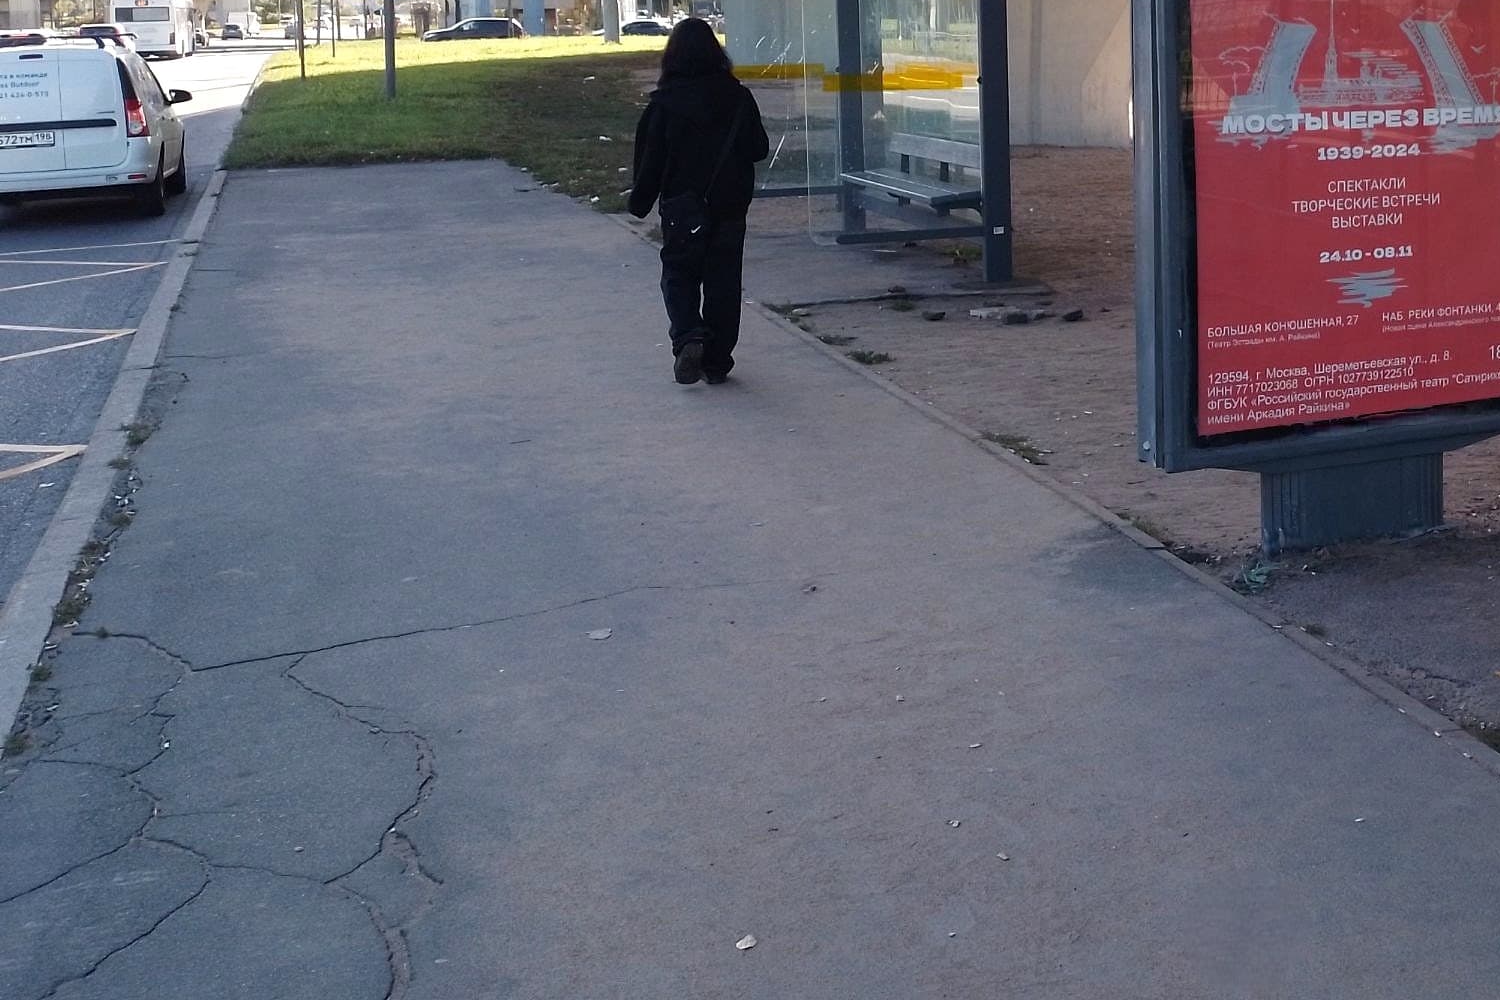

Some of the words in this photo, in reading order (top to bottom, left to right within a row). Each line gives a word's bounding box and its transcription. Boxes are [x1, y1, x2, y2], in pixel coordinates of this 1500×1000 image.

[1221, 111, 1328, 135] МОСТЫ
[1333, 108, 1420, 130] ЧЕРЕЗ
[1317, 143, 1420, 161] 1939-2024
[1327, 177, 1406, 193] СПЕКТАКЛИ
[1292, 196, 1379, 213] ТВОРЧЕСКИЕ
[1382, 193, 1441, 208] ВСТРЕЧИ
[1331, 213, 1403, 229] ВЫСТАВКИ
[1319, 249, 1363, 263] 24.10
[1373, 245, 1413, 259] 08.11
[1382, 310, 1405, 322] НАБ.
[1408, 308, 1435, 320] РЕКИ
[1437, 302, 1494, 317] ФОНТАНКИ,
[1207, 323, 1262, 338] БОЛЬШАЯ
[1264, 316, 1345, 333] КОНЮШЕННАЯ,
[1347, 314, 1359, 326] 27
[1208, 371, 1253, 385] 129594,
[1266, 366, 1311, 379] Москва,
[1314, 354, 1406, 378] Шереметьевская
[1207, 386, 1233, 398] ИНН
[1236, 379, 1298, 395] 7717023068
[1304, 375, 1334, 388] ОГРН
[1338, 367, 1414, 384] 1027739122510
[1207, 396, 1248, 411] ФГБУК
[1251, 388, 1322, 406] «Российский
[1325, 377, 1418, 400] государственный
[1420, 376, 1449, 388] театр
[1207, 414, 1244, 425] имени
[1247, 407, 1295, 423] Аркадия
[1298, 401, 1351, 416] Райкина»
